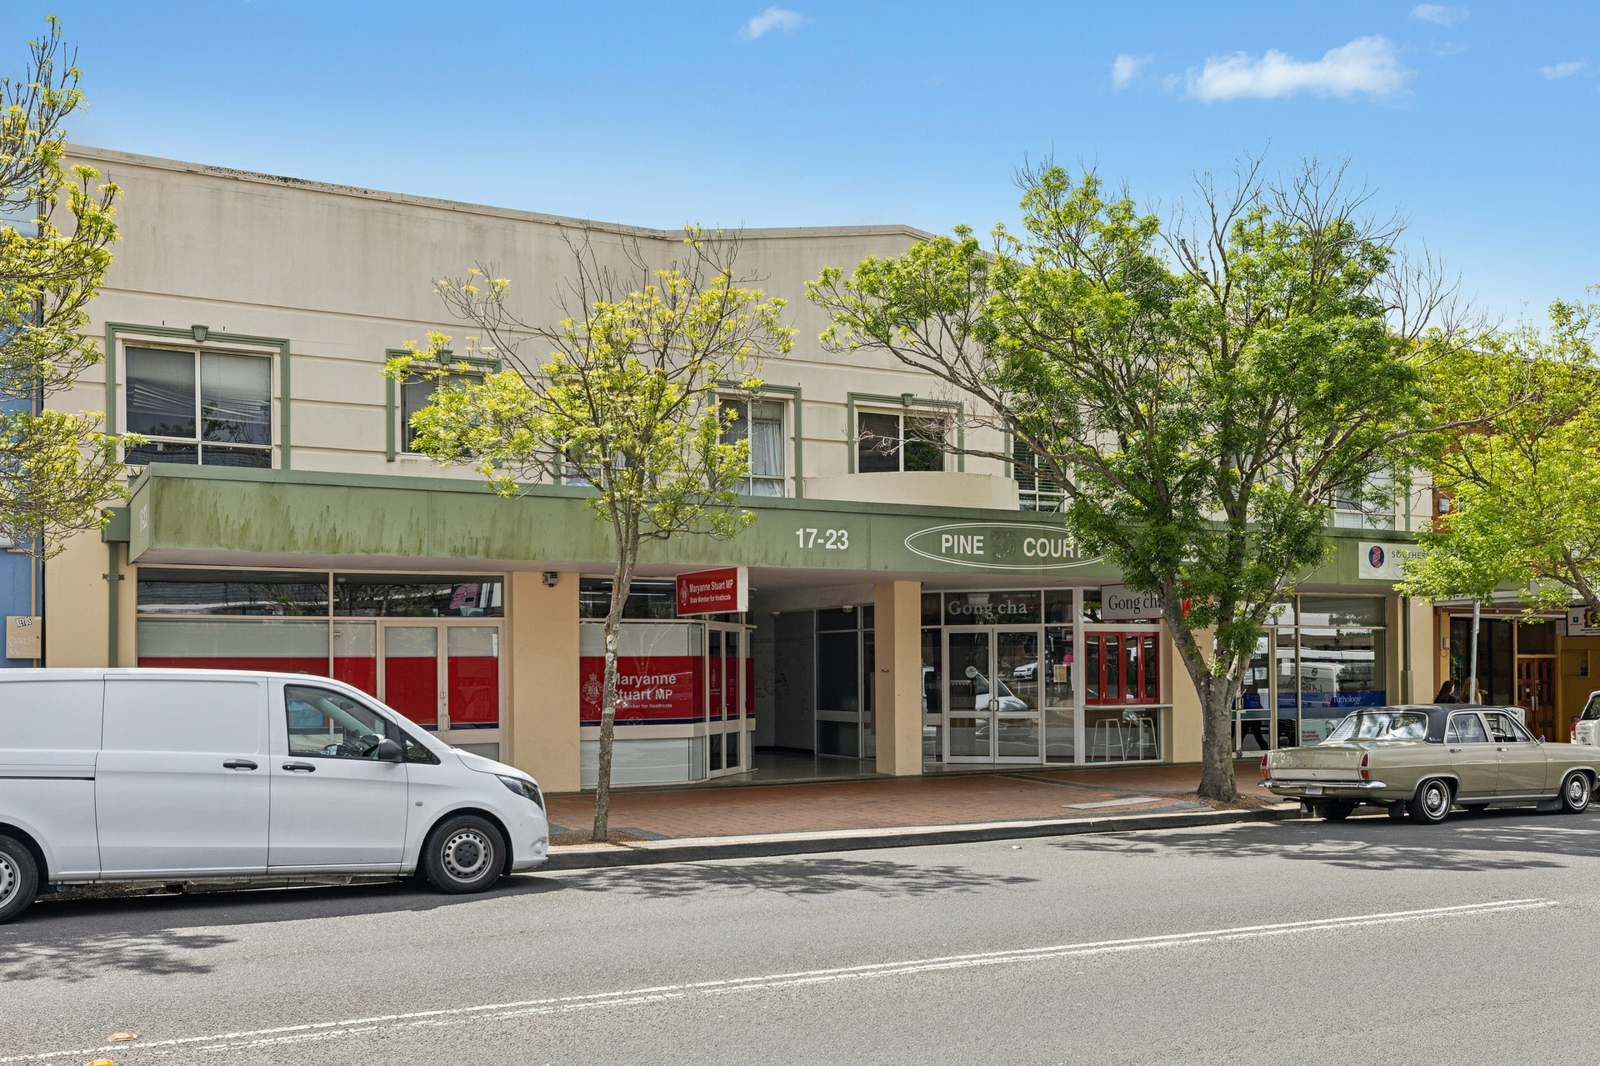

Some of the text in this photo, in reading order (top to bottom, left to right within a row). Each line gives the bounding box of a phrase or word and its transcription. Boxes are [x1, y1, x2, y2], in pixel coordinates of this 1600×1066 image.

[796, 528, 849, 550] 17-23
[941, 534, 984, 555] PINE
[689, 579, 734, 595] Maryanne Stuart MP
[948, 599, 1028, 620] Gong cha
[1108, 594, 1141, 615] Gong
[615, 673, 677, 688] Maryanne
[614, 688, 651, 701] Stuart
[655, 689, 673, 700] MP
[1333, 695, 1361, 705] Pathology
